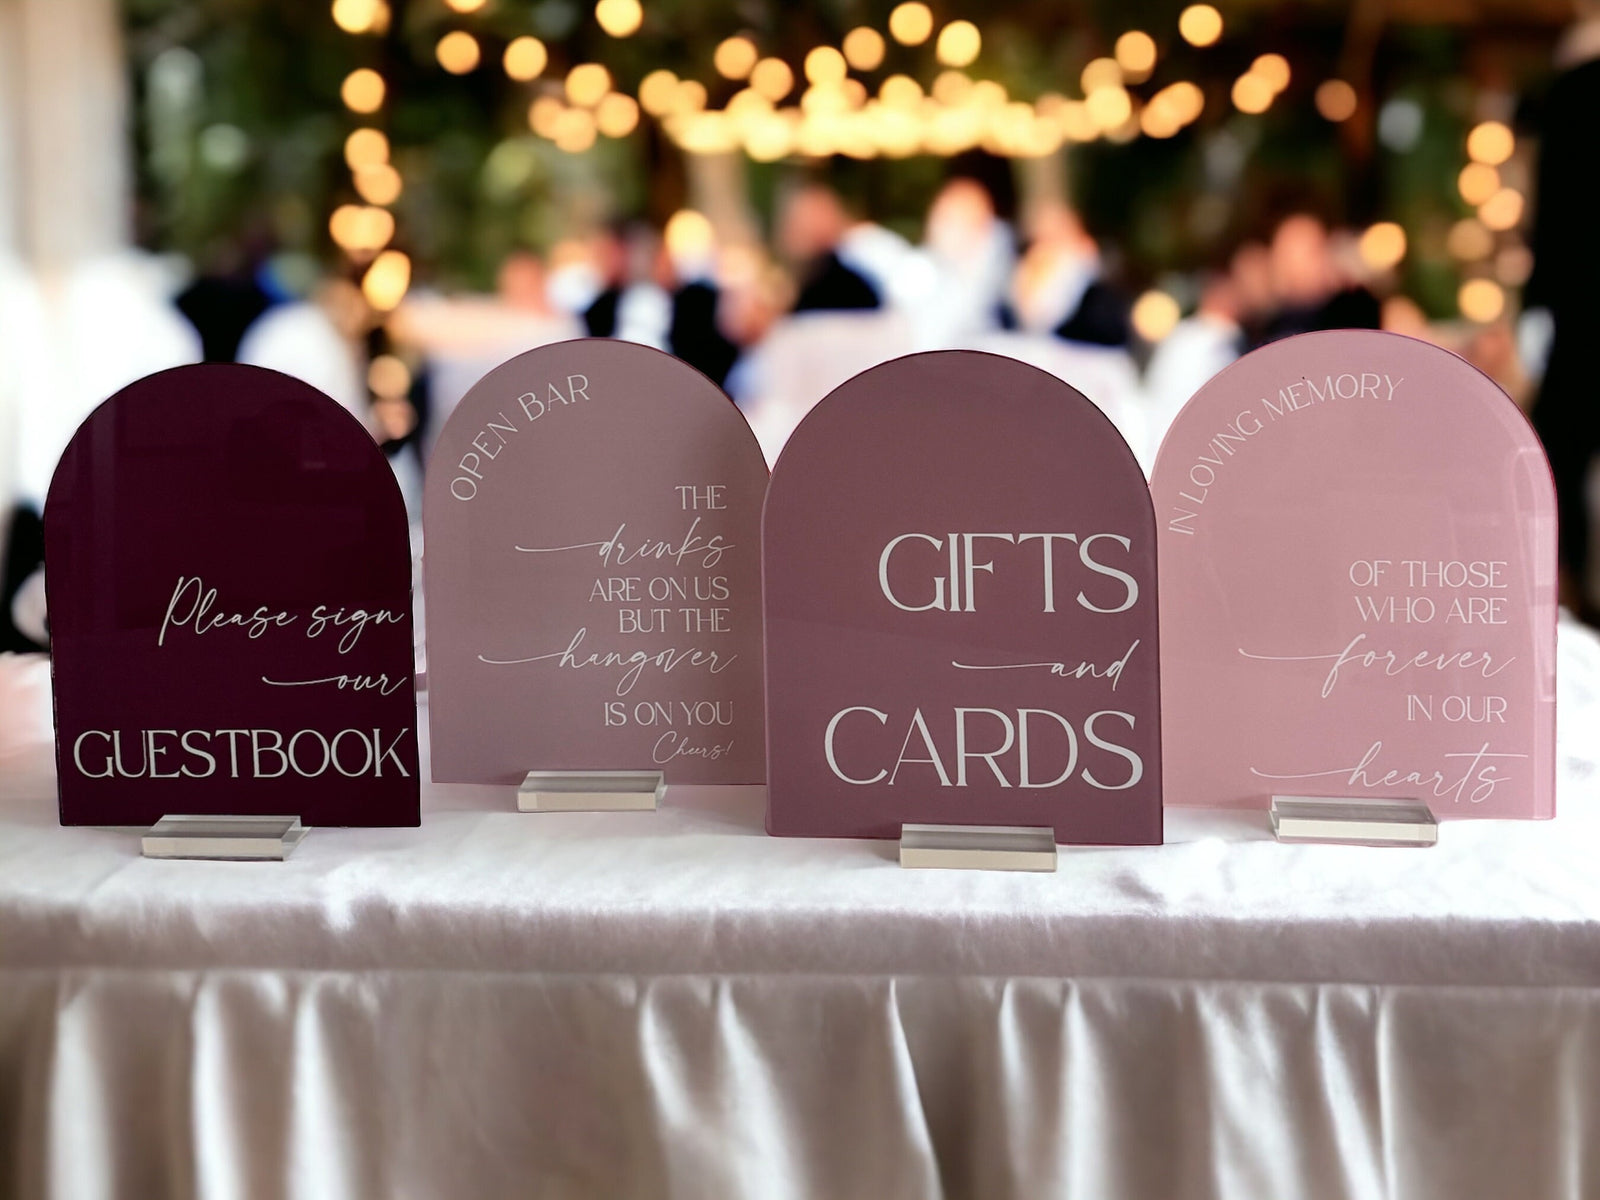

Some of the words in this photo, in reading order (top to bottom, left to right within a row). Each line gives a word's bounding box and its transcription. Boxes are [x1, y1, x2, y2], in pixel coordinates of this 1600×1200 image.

[1261, 372, 1405, 421] MEMORY
[450, 411, 520, 502] OPEN
[517, 373, 592, 422] BAR
[1179, 410, 1264, 504] LOVING
[674, 485, 727, 511] THE
[1167, 506, 1196, 536] IN
[514, 516, 736, 569] drinks
[588, 577, 642, 602] ARE
[648, 576, 688, 602] ON
[693, 576, 730, 602] US
[878, 532, 1140, 614] GIFTS
[1348, 560, 1392, 588] OF
[1400, 560, 1509, 589] THOSE
[158, 576, 299, 646] Please
[306, 604, 405, 654] sign
[618, 608, 670, 634] BUT
[678, 608, 732, 633] THE
[1354, 596, 1436, 625] WHO
[1445, 596, 1509, 625] ARE
[262, 673, 407, 696] our
[477, 627, 737, 697] hangover
[951, 638, 1141, 692] and
[1237, 633, 1517, 699] forever
[604, 701, 627, 727] IS
[634, 701, 673, 727] ON
[679, 701, 734, 726] YOU
[1406, 695, 1434, 722] IN
[1442, 695, 1508, 724] OUR
[73, 728, 411, 779] GUESTBOOK
[652, 731, 735, 765] Cheers!
[823, 706, 1145, 790] CARDS
[1250, 741, 1529, 804] hearts
